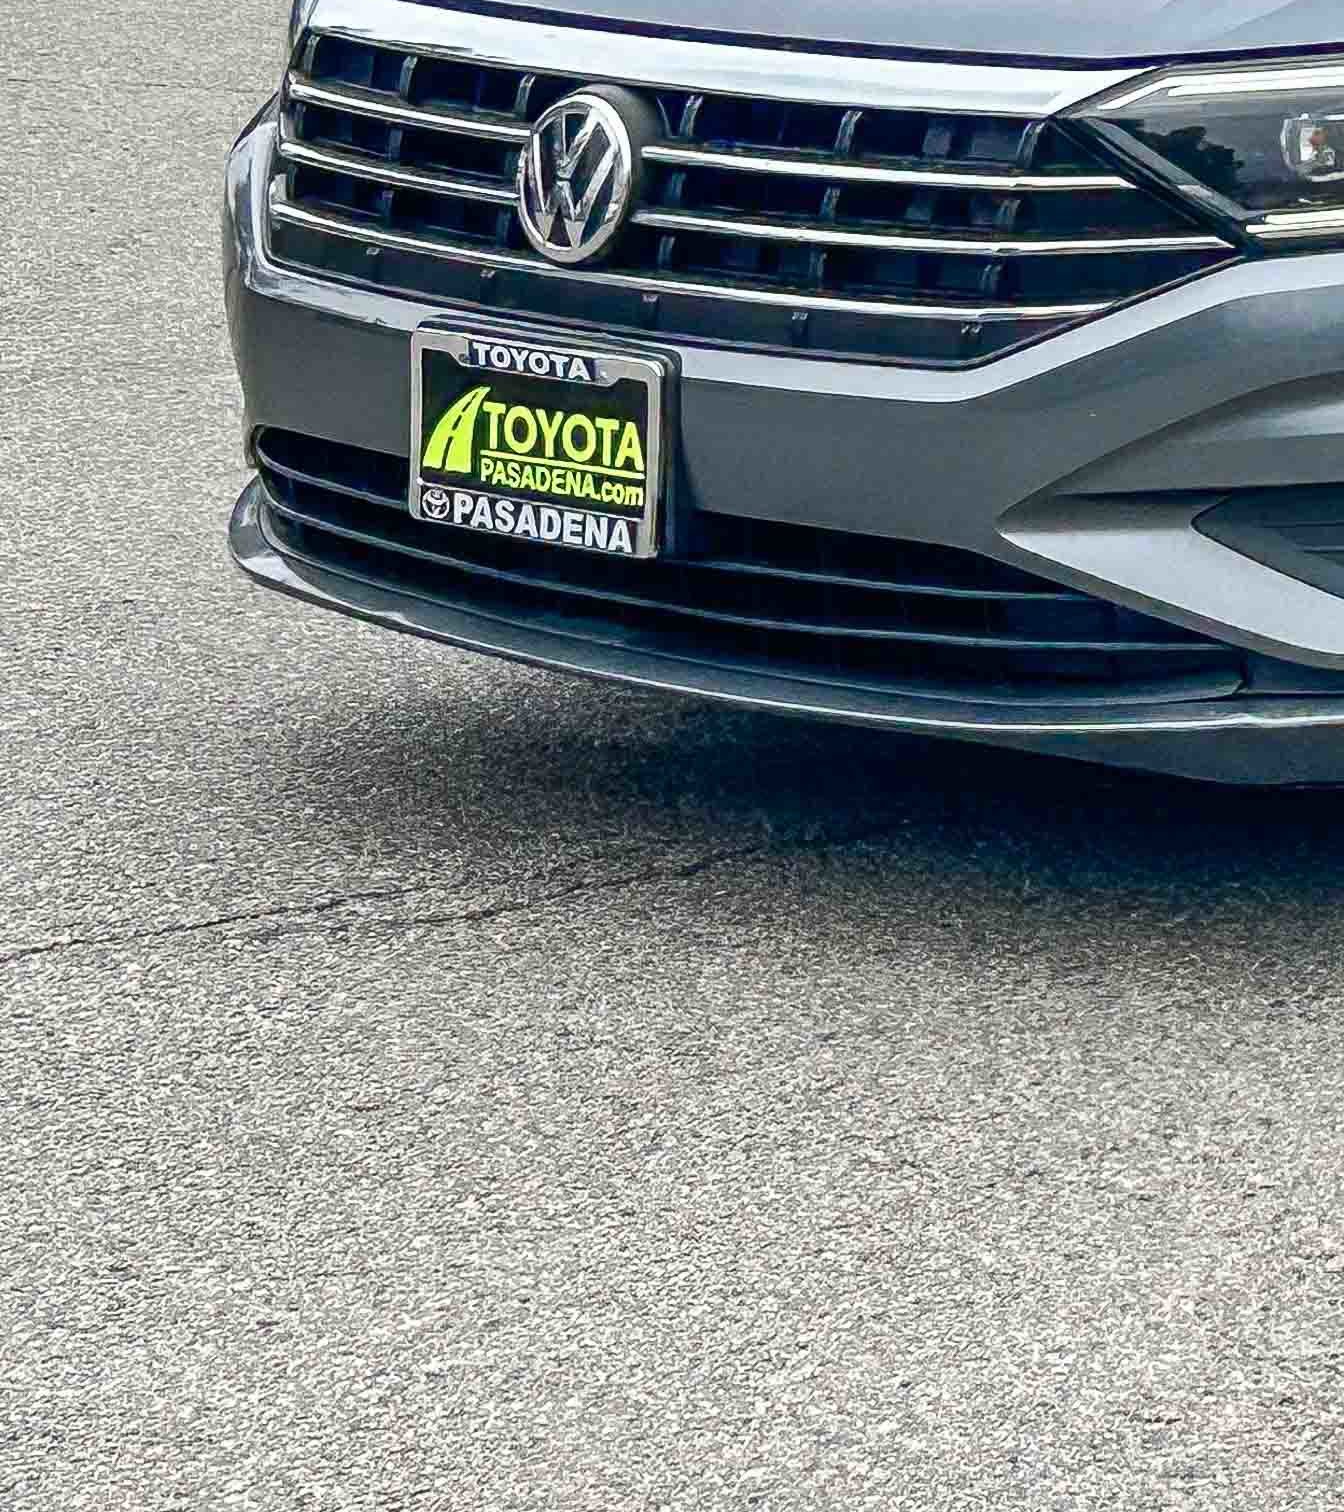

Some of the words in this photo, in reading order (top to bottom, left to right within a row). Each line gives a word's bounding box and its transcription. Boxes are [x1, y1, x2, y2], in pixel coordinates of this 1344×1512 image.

[473, 342, 592, 382] TOYOTA
[482, 401, 645, 471] TOYOTA
[480, 458, 644, 506] PASADENA.com
[453, 493, 632, 553] PASADENA
